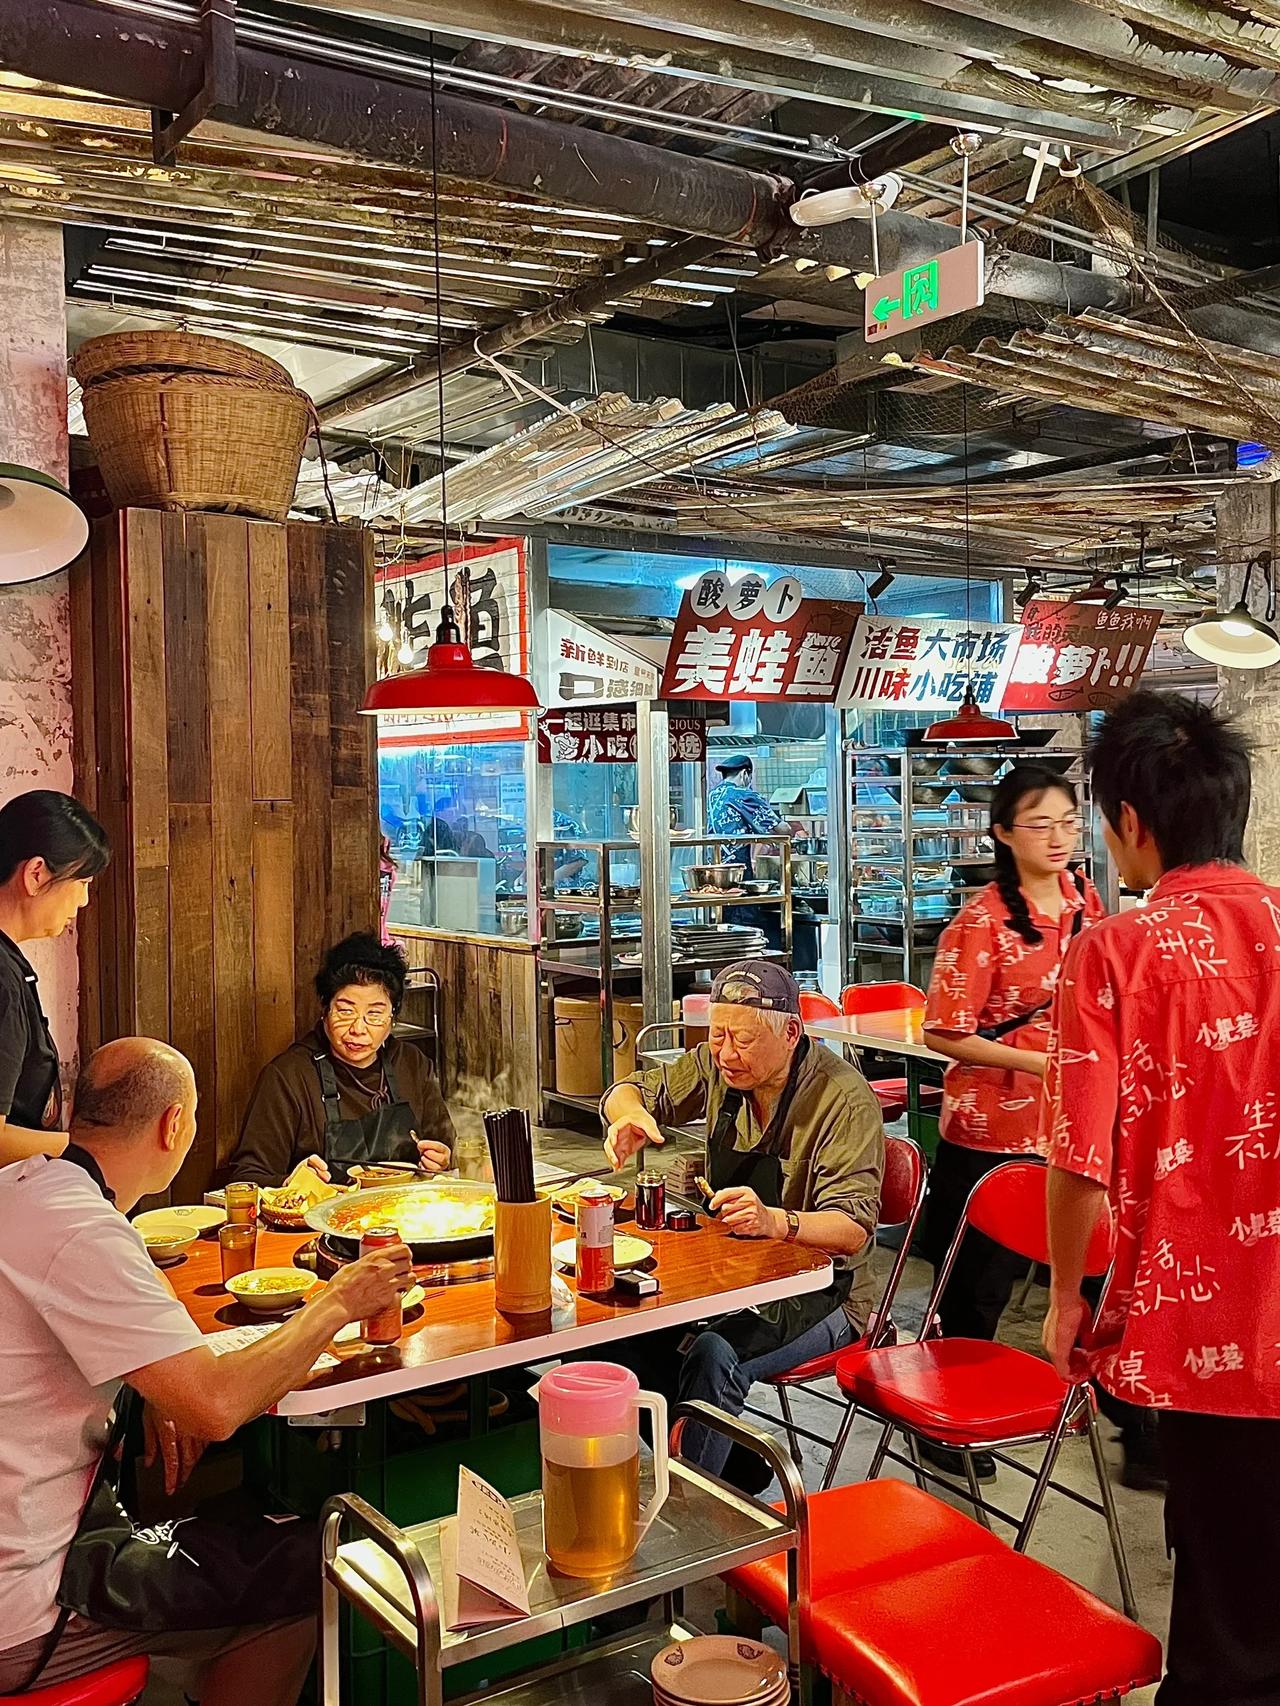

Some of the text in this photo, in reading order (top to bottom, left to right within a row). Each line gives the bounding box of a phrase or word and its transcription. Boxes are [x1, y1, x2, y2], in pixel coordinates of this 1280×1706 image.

[697, 577, 794, 616] 酸萝卜
[560, 637, 629, 674] 新鲜到店
[669, 624, 842, 696] 美蛙鱼
[860, 625, 1011, 665] 活鱼大市场
[850, 665, 1000, 704] 川味小吃铺
[546, 711, 637, 732] 一起逛集市
